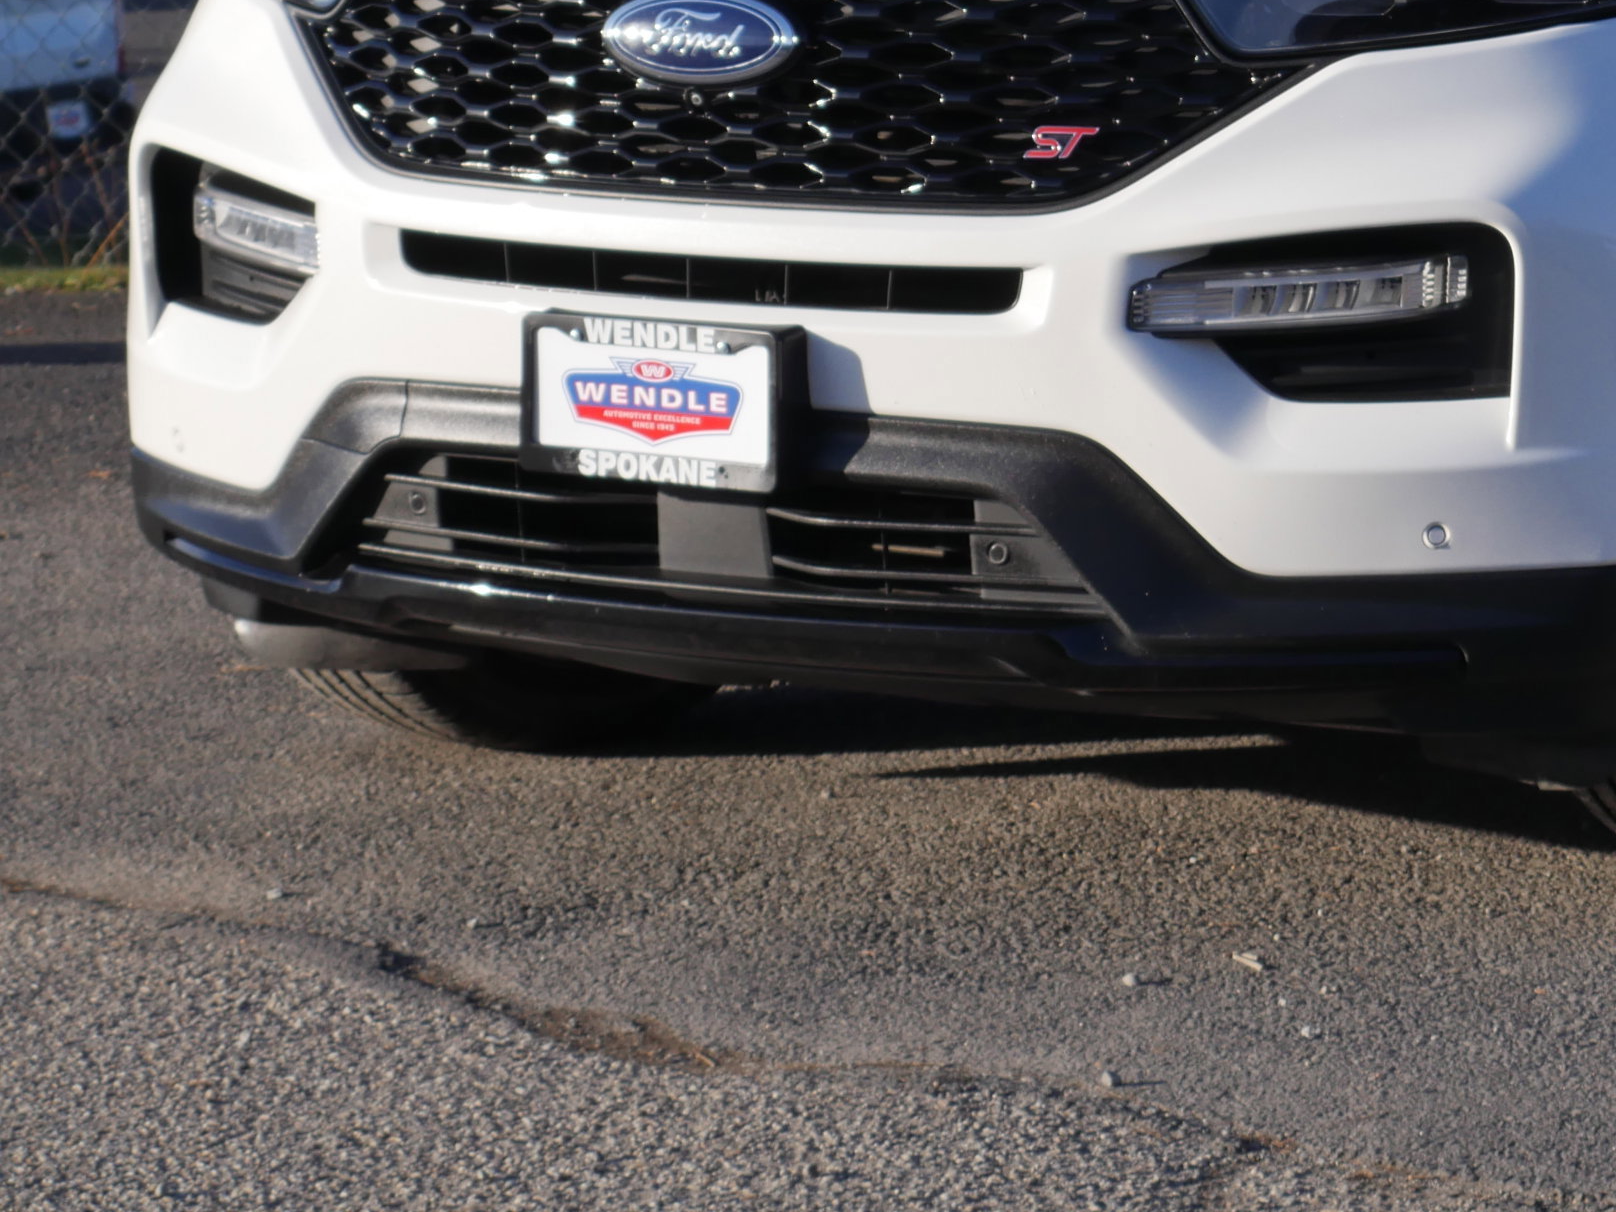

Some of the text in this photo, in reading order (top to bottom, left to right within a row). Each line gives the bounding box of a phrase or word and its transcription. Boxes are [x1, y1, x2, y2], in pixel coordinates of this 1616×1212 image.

[651, 7, 744, 58] Ford
[1023, 126, 1100, 159] ST
[583, 316, 715, 354] WENDLE
[574, 381, 729, 414] WENDLE
[578, 449, 717, 487] SPOKANE
